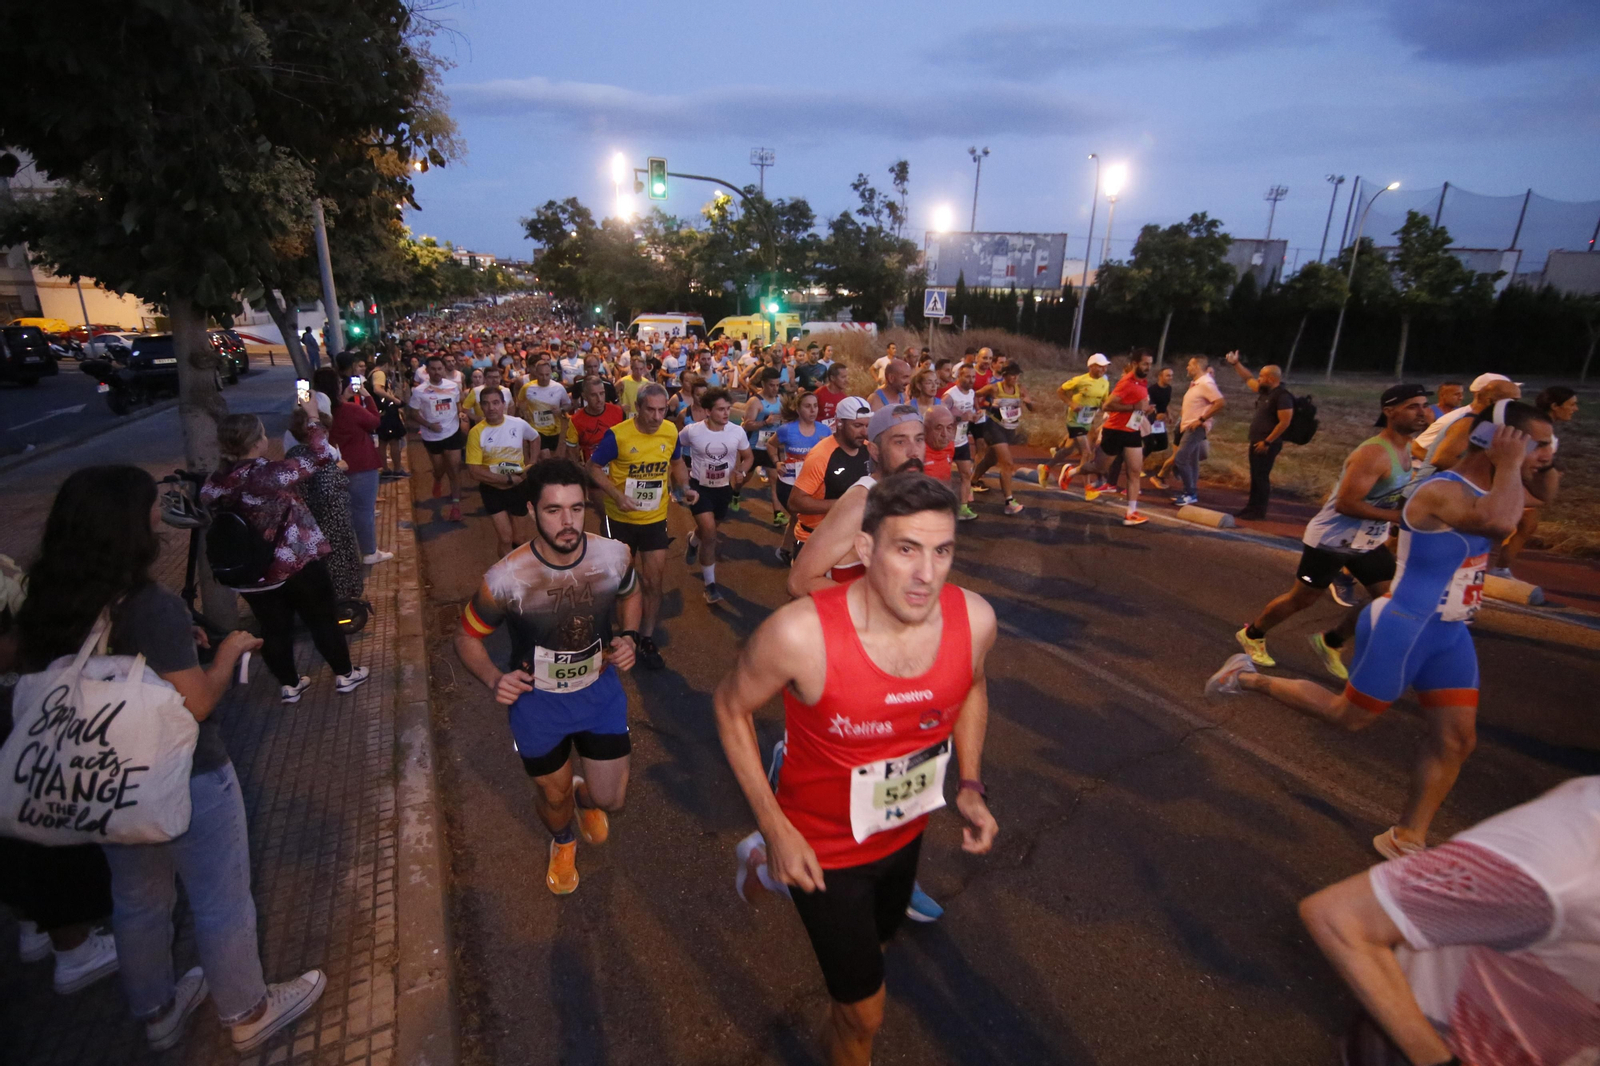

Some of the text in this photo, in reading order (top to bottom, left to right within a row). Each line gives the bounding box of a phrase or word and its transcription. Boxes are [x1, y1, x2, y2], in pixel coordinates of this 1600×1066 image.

[706, 472, 725, 480] 1839
[636, 491, 654, 500] 793
[547, 582, 595, 613] 714
[557, 654, 572, 664] 21
[555, 665, 588, 679] 650
[28, 685, 127, 751] Small
[69, 748, 133, 777] acts
[14, 741, 150, 810] CHANGE
[885, 773, 926, 805] 523
[46, 802, 78, 816] THE
